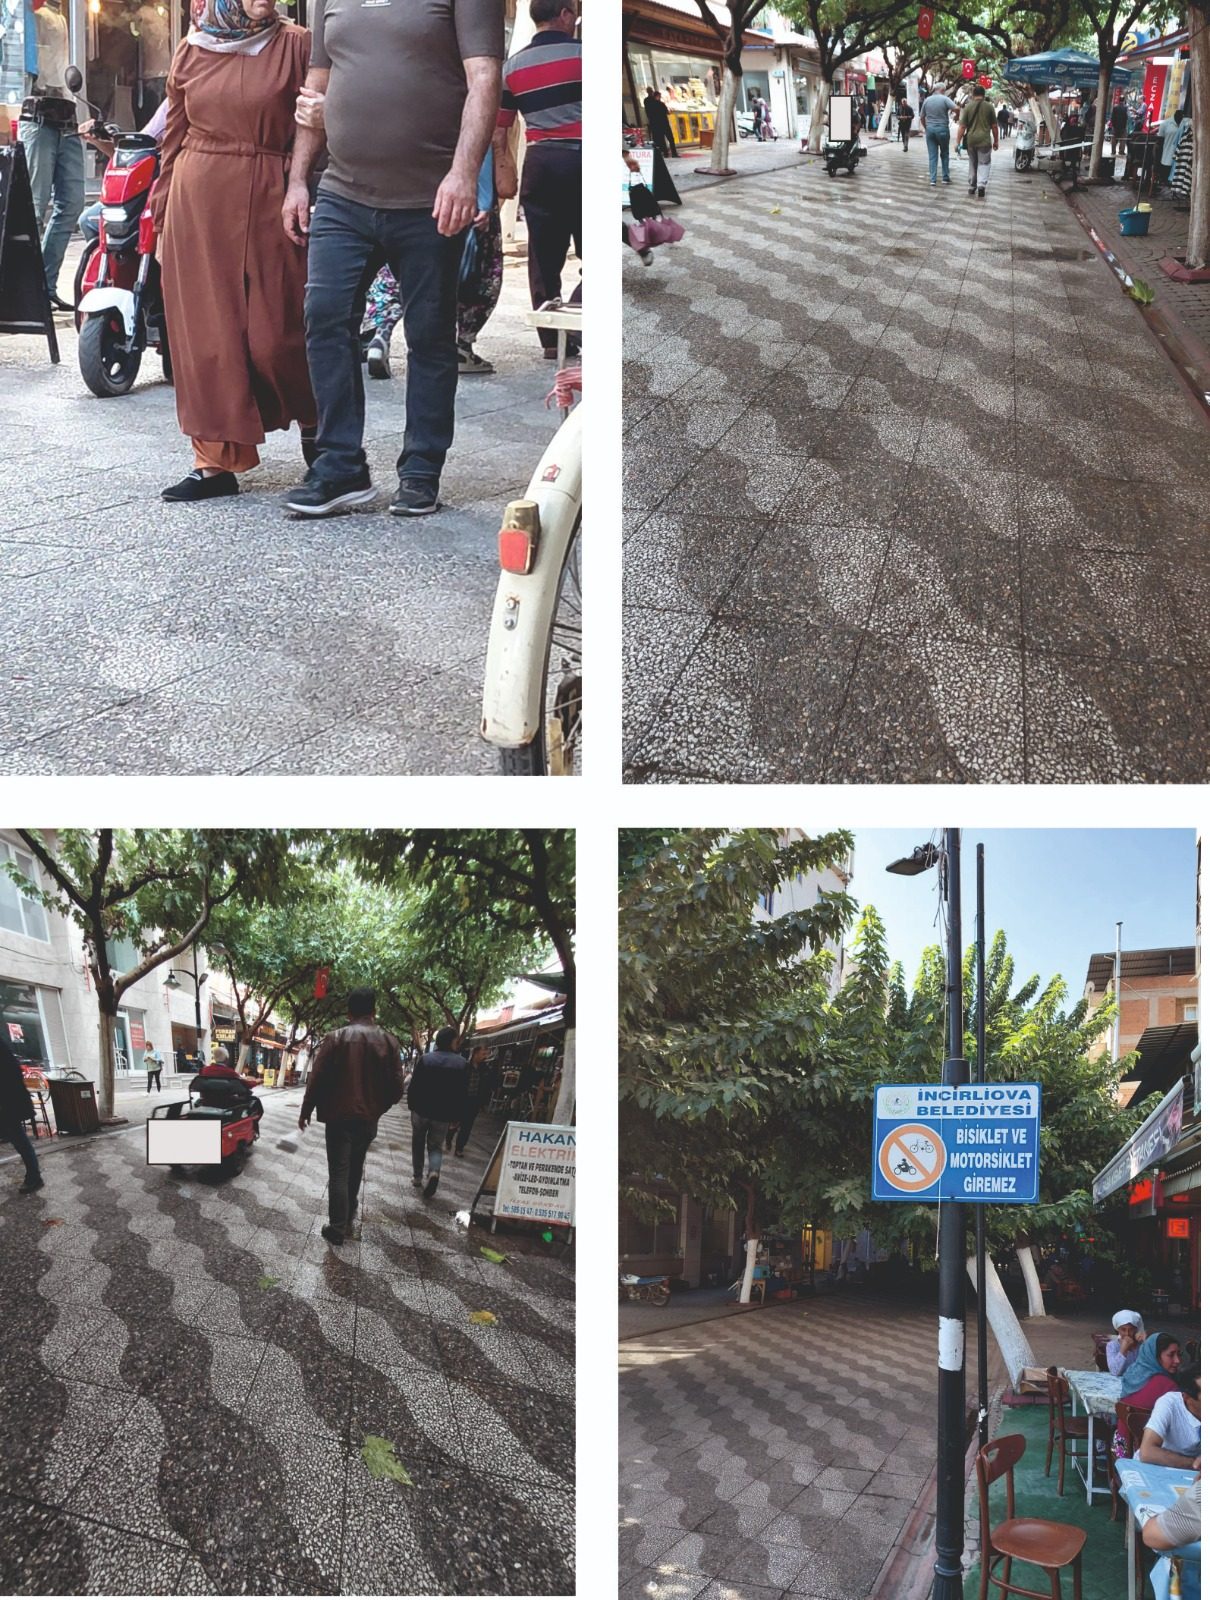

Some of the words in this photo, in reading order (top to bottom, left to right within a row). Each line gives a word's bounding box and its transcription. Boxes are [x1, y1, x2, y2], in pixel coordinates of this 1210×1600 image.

[918, 1088, 1032, 1101] İNCİRLİOVA
[917, 1103, 1031, 1116] BELEDİYESİ
[519, 1131, 576, 1146] HAKAN
[956, 1124, 1008, 1144] BİSİKLET
[1012, 1128, 1027, 1144] VE
[950, 1148, 1032, 1169] MOTORSİKLET
[963, 1172, 1016, 1193] GİREMEZ
